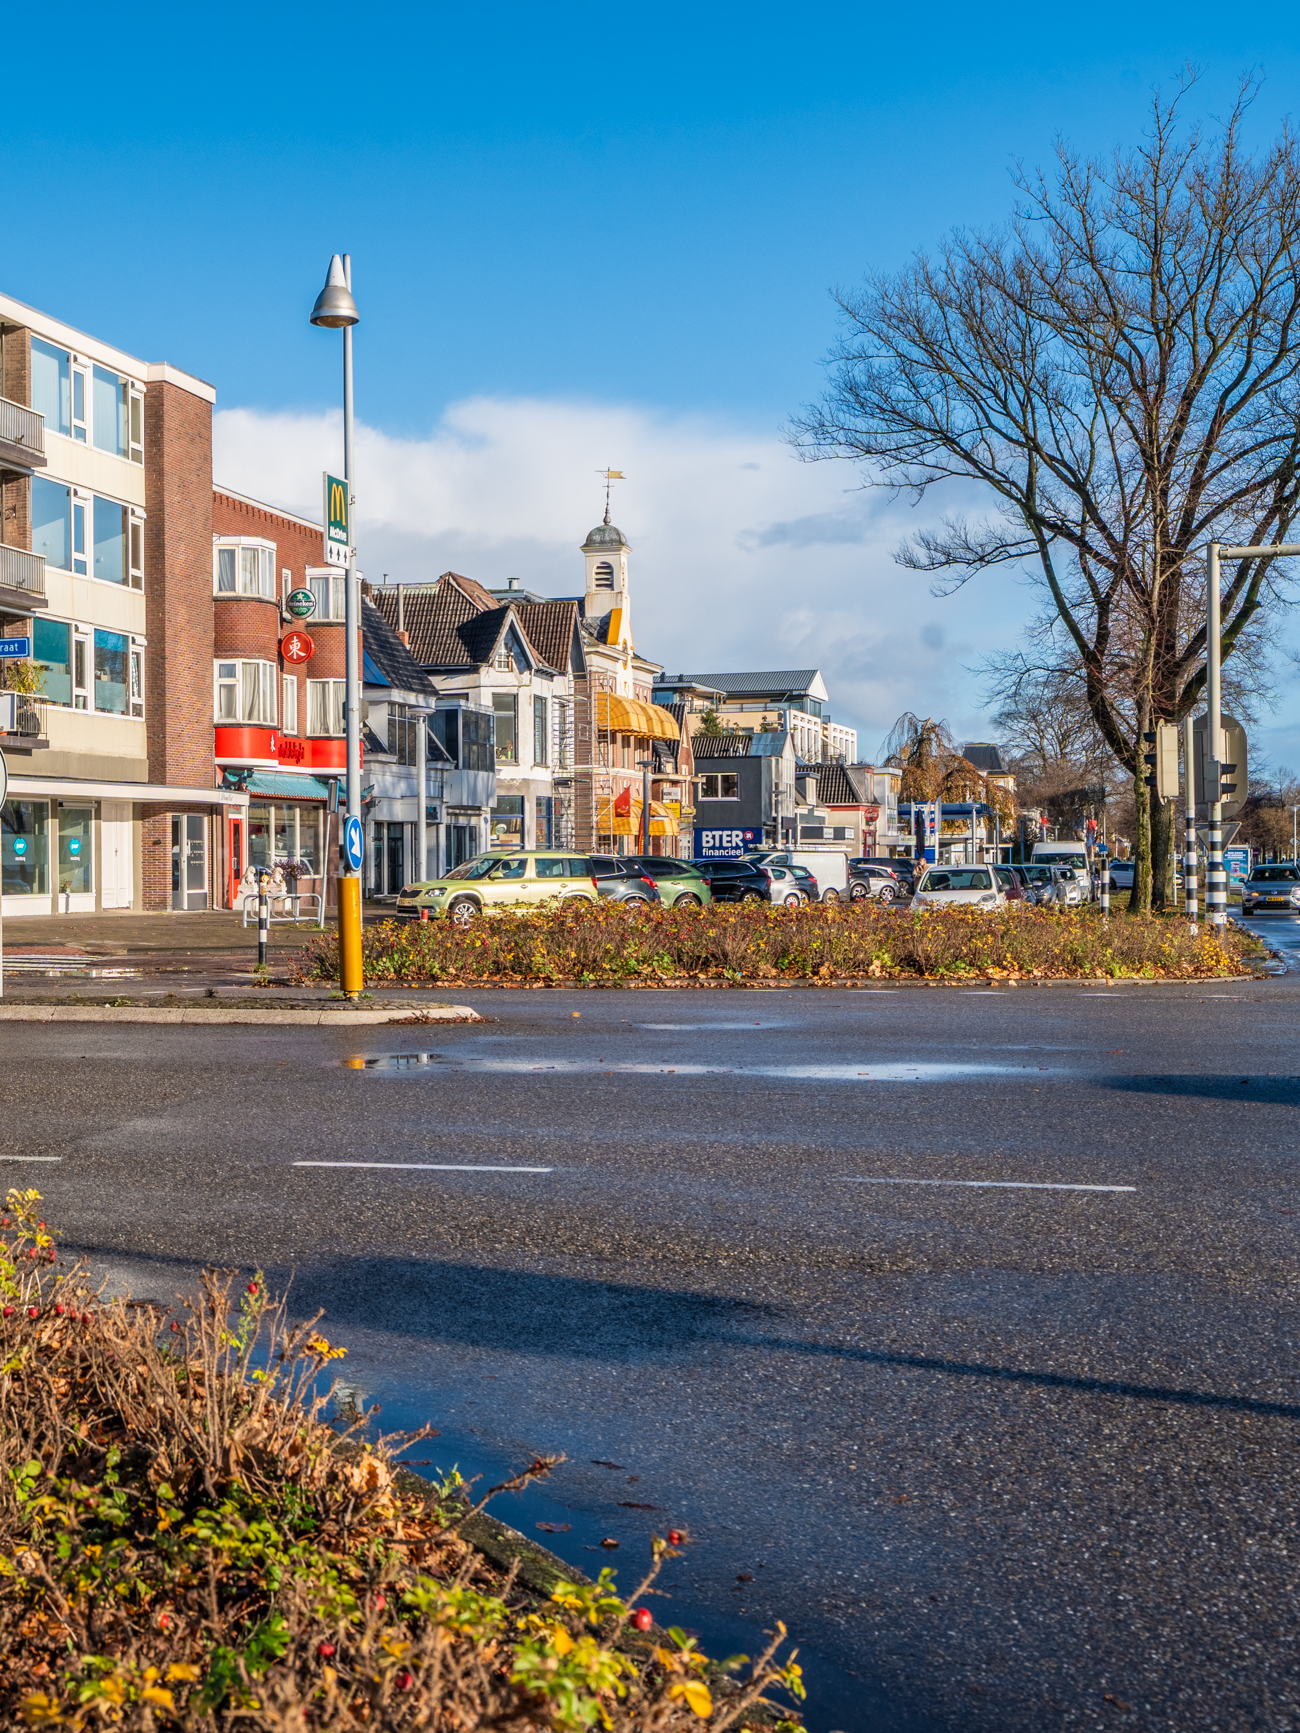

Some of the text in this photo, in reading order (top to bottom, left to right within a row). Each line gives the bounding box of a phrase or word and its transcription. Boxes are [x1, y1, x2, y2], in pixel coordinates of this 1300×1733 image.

[329, 525, 347, 541] McDrive
[287, 635, 307, 660] 東
[702, 831, 743, 847] BTER
[702, 848, 743, 857] financieel
